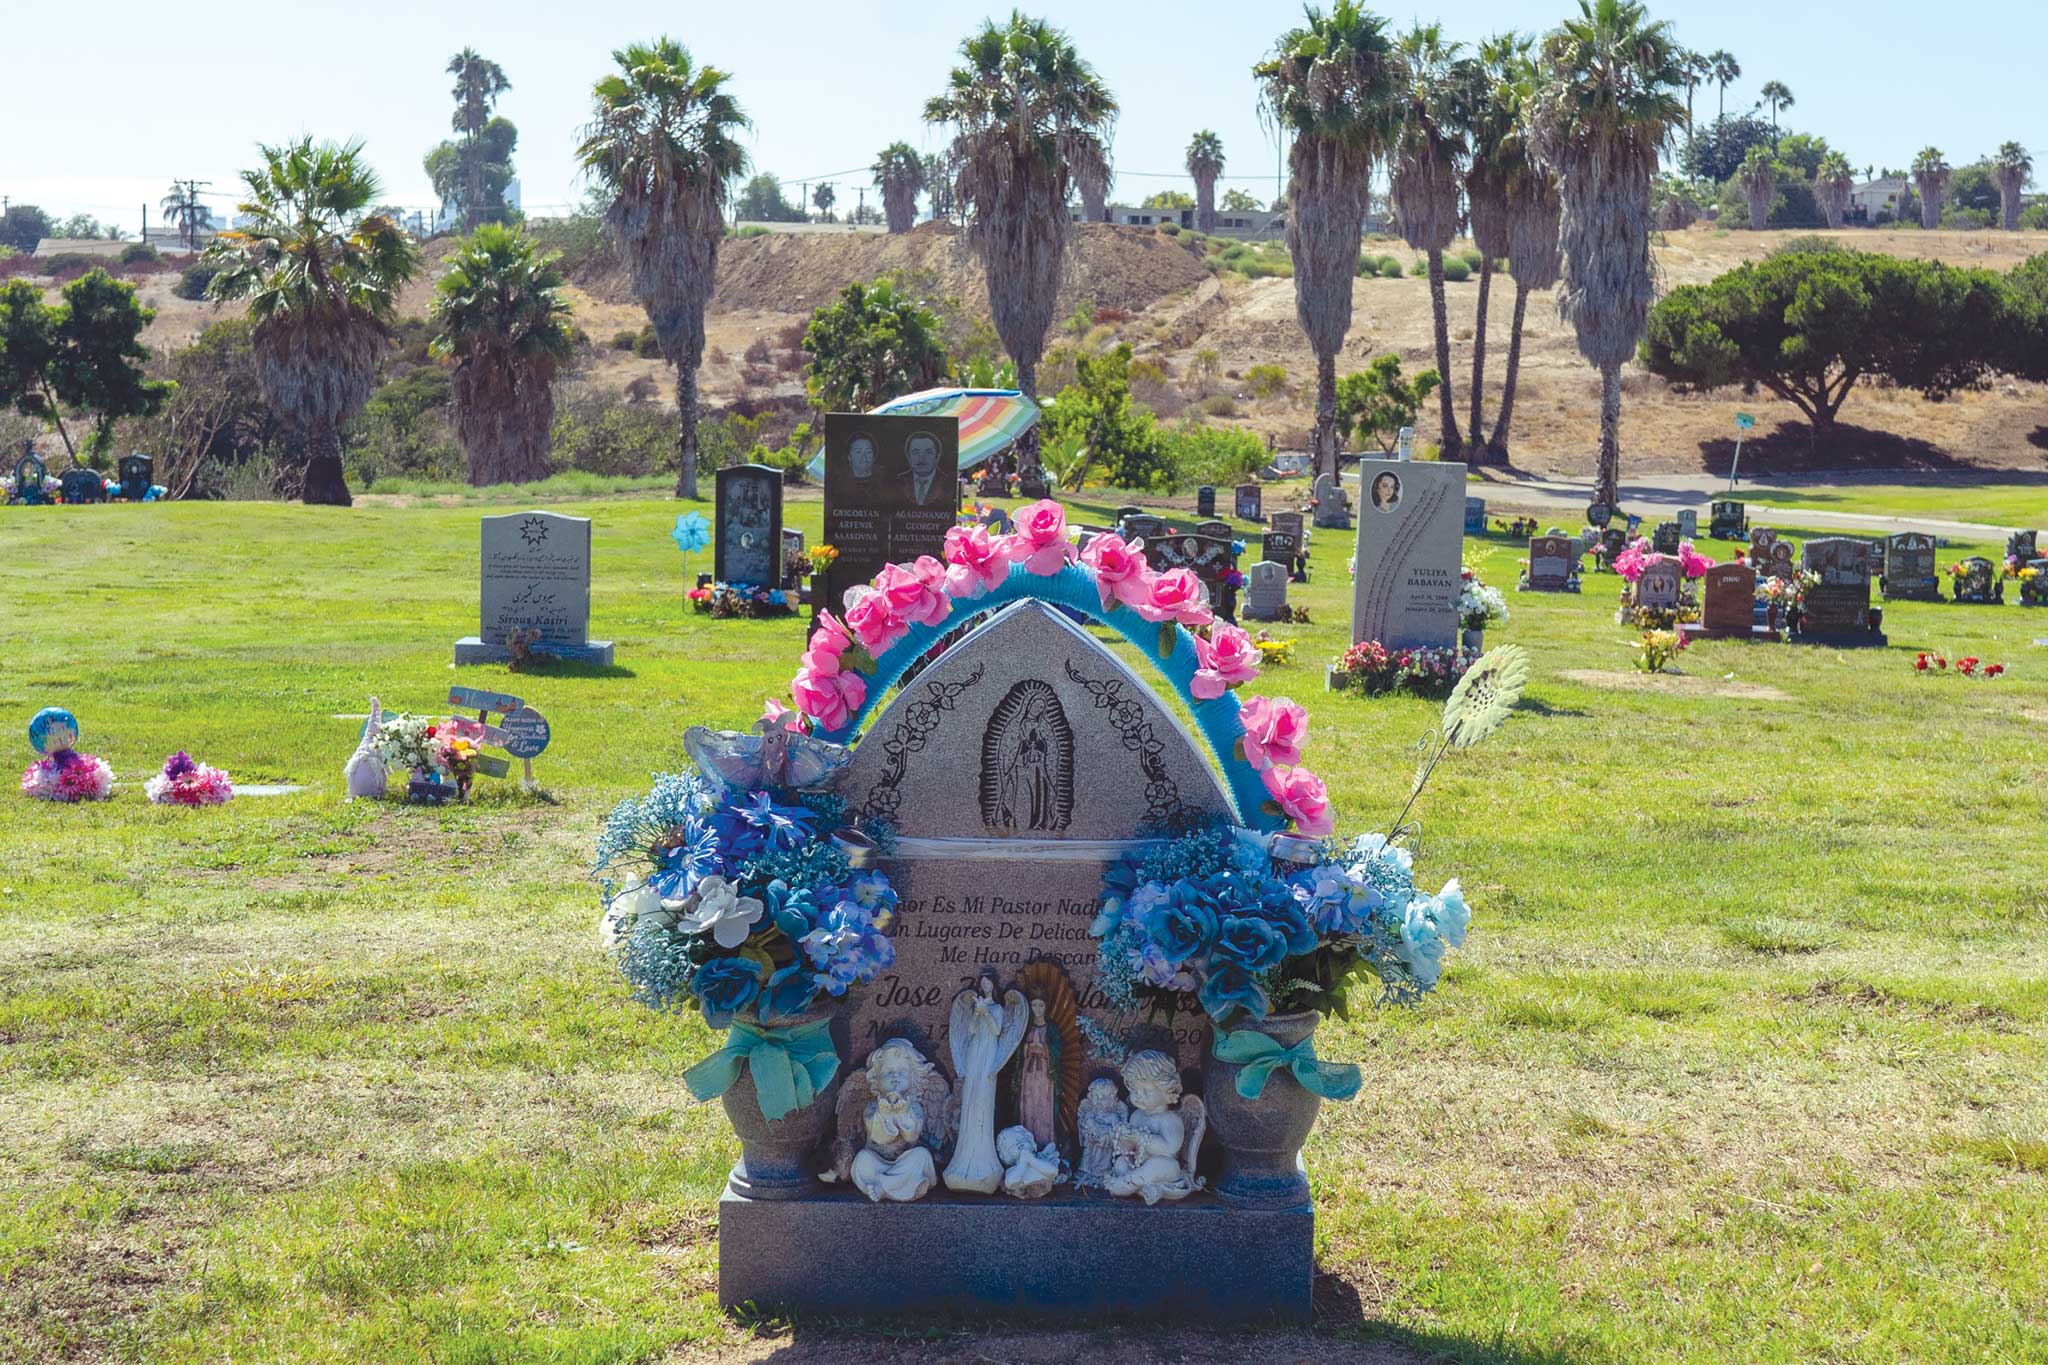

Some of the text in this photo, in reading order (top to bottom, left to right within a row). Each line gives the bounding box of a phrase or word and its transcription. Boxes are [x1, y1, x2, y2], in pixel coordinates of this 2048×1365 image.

[1413, 568, 1447, 576] YULIYA
[1407, 579, 1451, 587] BABAYAN
[499, 614, 568, 625] Sirous Kasiri
[517, 740, 539, 753] Love
[932, 896, 956, 914] Es
[963, 895, 985, 914] Mi
[990, 896, 1052, 915] Pastor
[916, 920, 992, 943] Lugares
[998, 921, 1024, 940] De
[940, 946, 1101, 965] Me Hara Descan
[876, 975, 942, 1007] Jose
